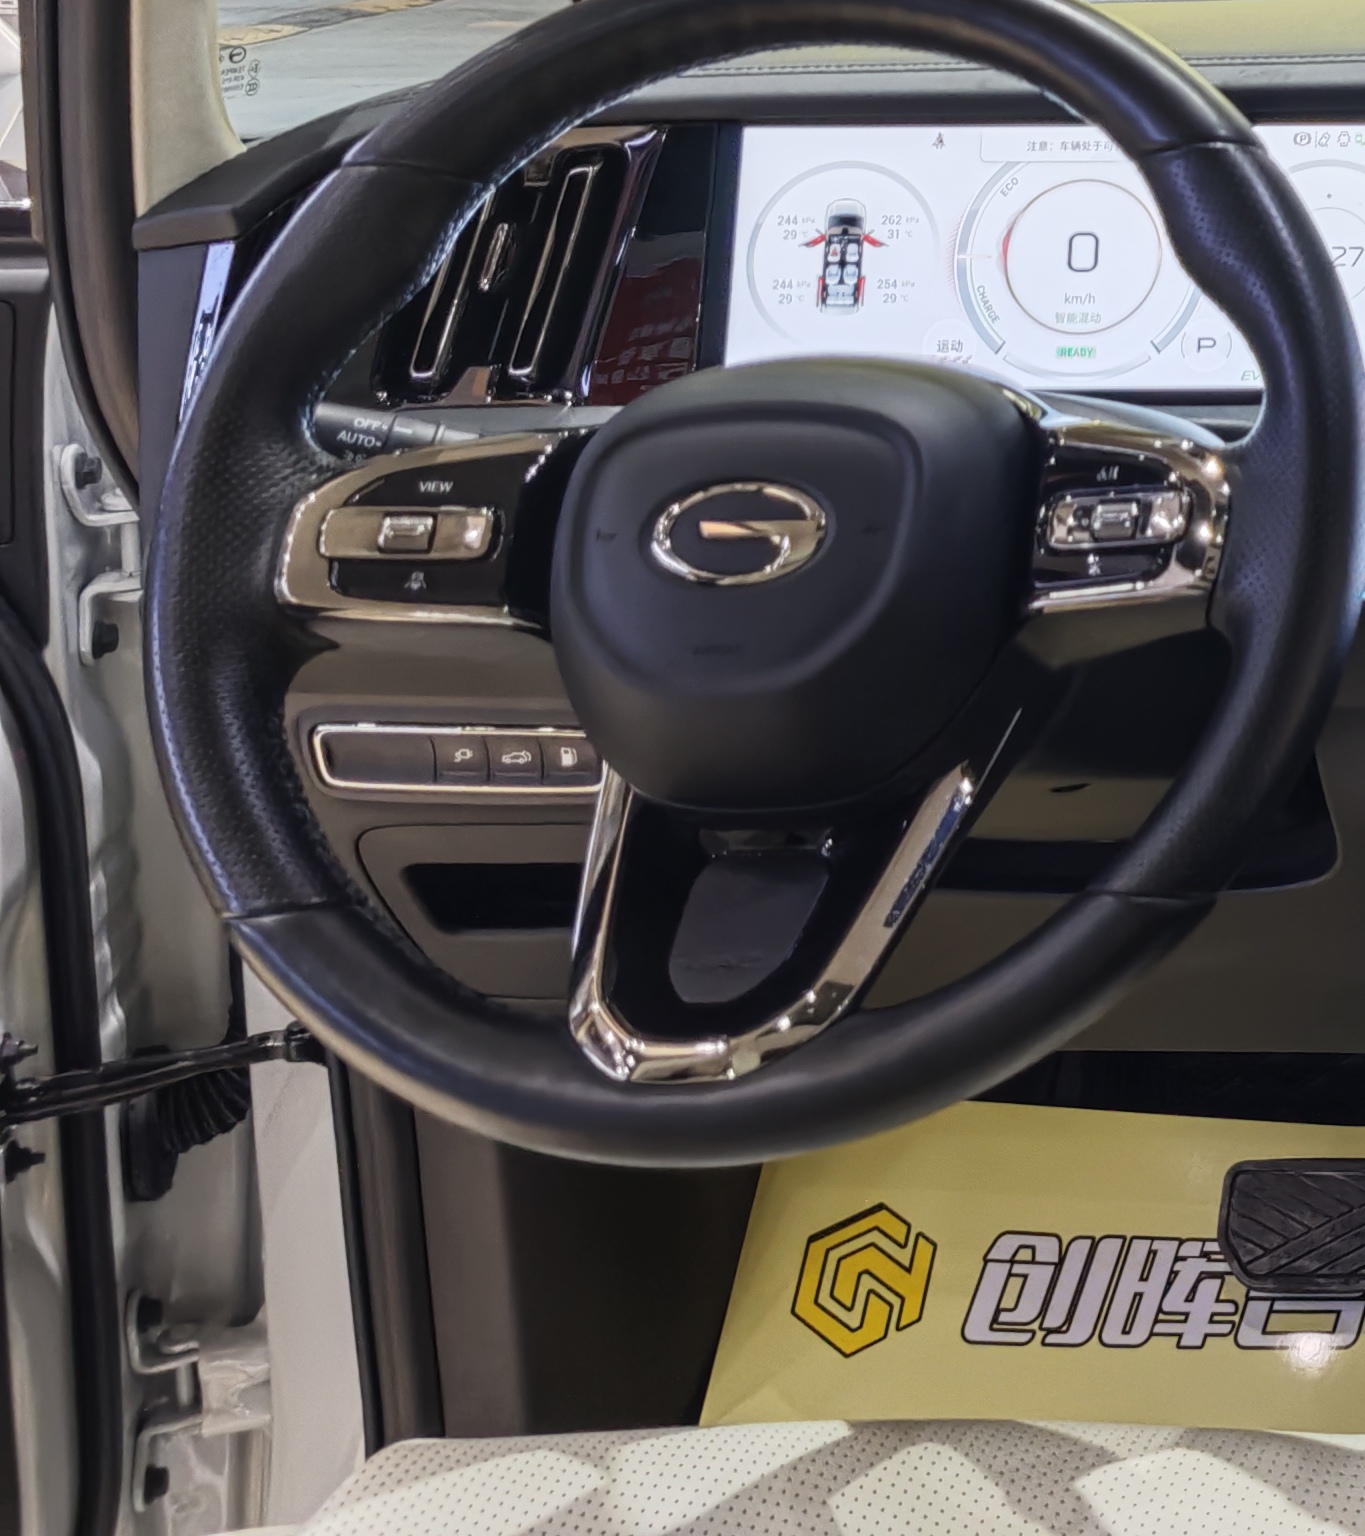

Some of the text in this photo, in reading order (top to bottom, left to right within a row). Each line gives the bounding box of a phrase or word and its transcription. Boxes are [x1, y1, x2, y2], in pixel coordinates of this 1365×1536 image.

[1000, 177, 1019, 197] ECO
[777, 216, 798, 226] 244
[881, 215, 902, 225] 262
[783, 229, 797, 239] 29
[887, 229, 900, 239] 31
[1067, 232, 1099, 272] 0
[772, 279, 793, 289] 244
[778, 293, 792, 304] 29
[883, 293, 897, 303] 29
[1064, 293, 1096, 306] km/h
[976, 285, 1000, 324] CHARGE
[936, 339, 963, 353] 运动
[1197, 337, 1216, 353] P
[1060, 347, 1094, 358] READY
[354, 418, 381, 430] OFF
[337, 431, 375, 446] AUTO
[419, 481, 453, 493] VIEW
